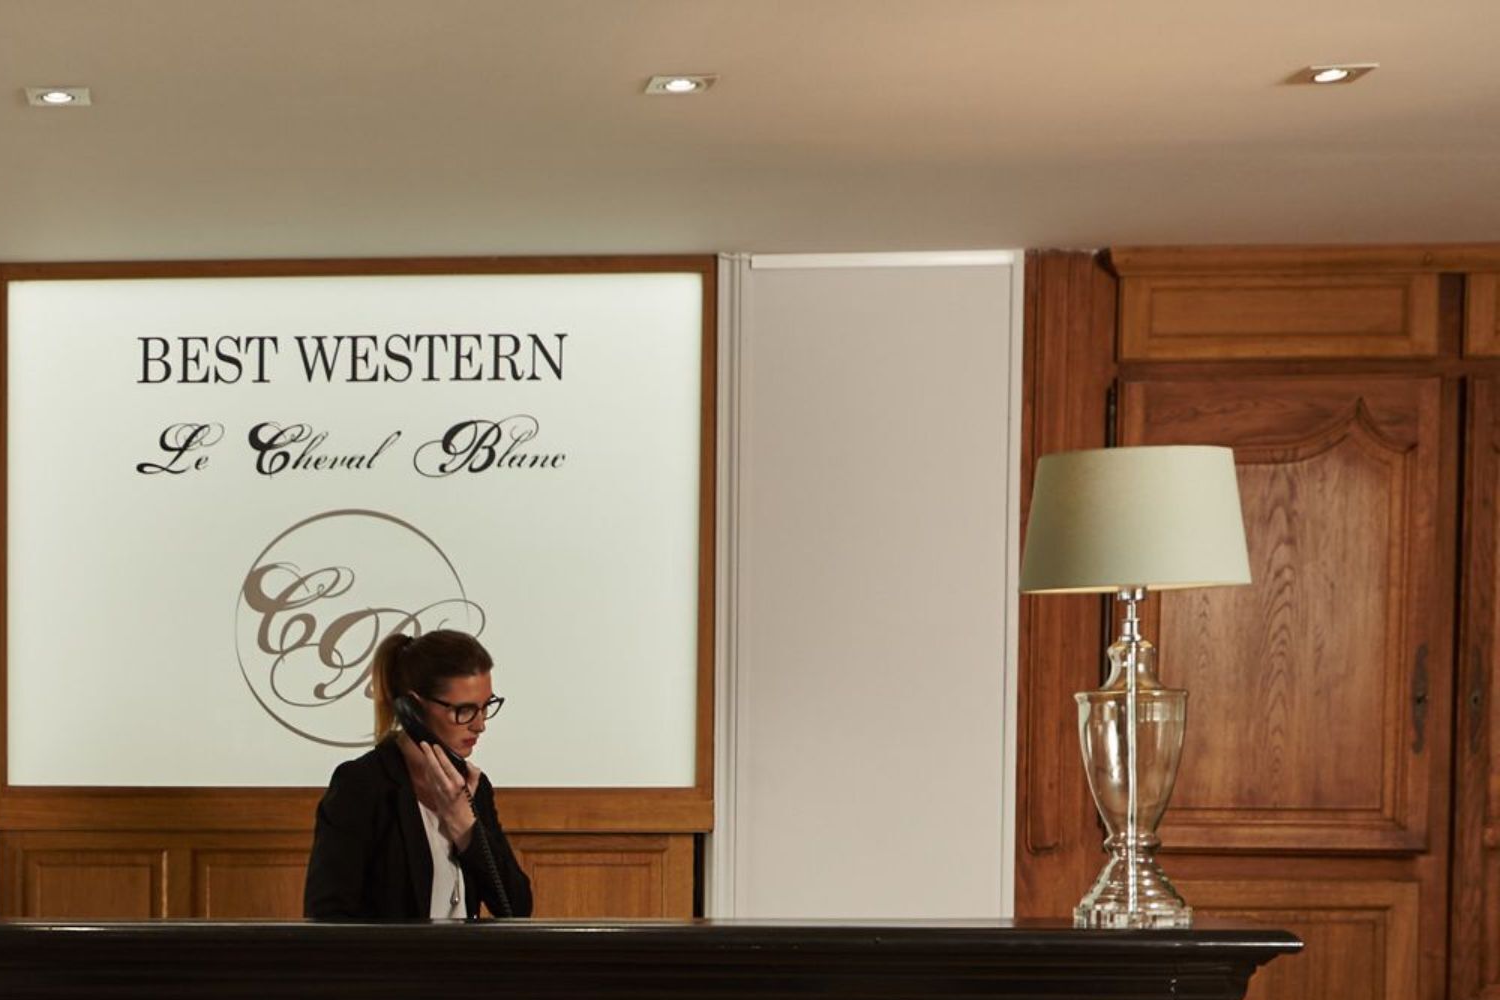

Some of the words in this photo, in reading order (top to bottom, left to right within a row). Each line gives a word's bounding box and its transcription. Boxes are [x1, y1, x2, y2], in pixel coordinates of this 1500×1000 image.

[136, 335, 279, 385] BEST
[293, 333, 569, 384] WESTERN
[136, 422, 225, 475] Le
[248, 422, 402, 478] Cheval
[413, 414, 566, 478] Blanc
